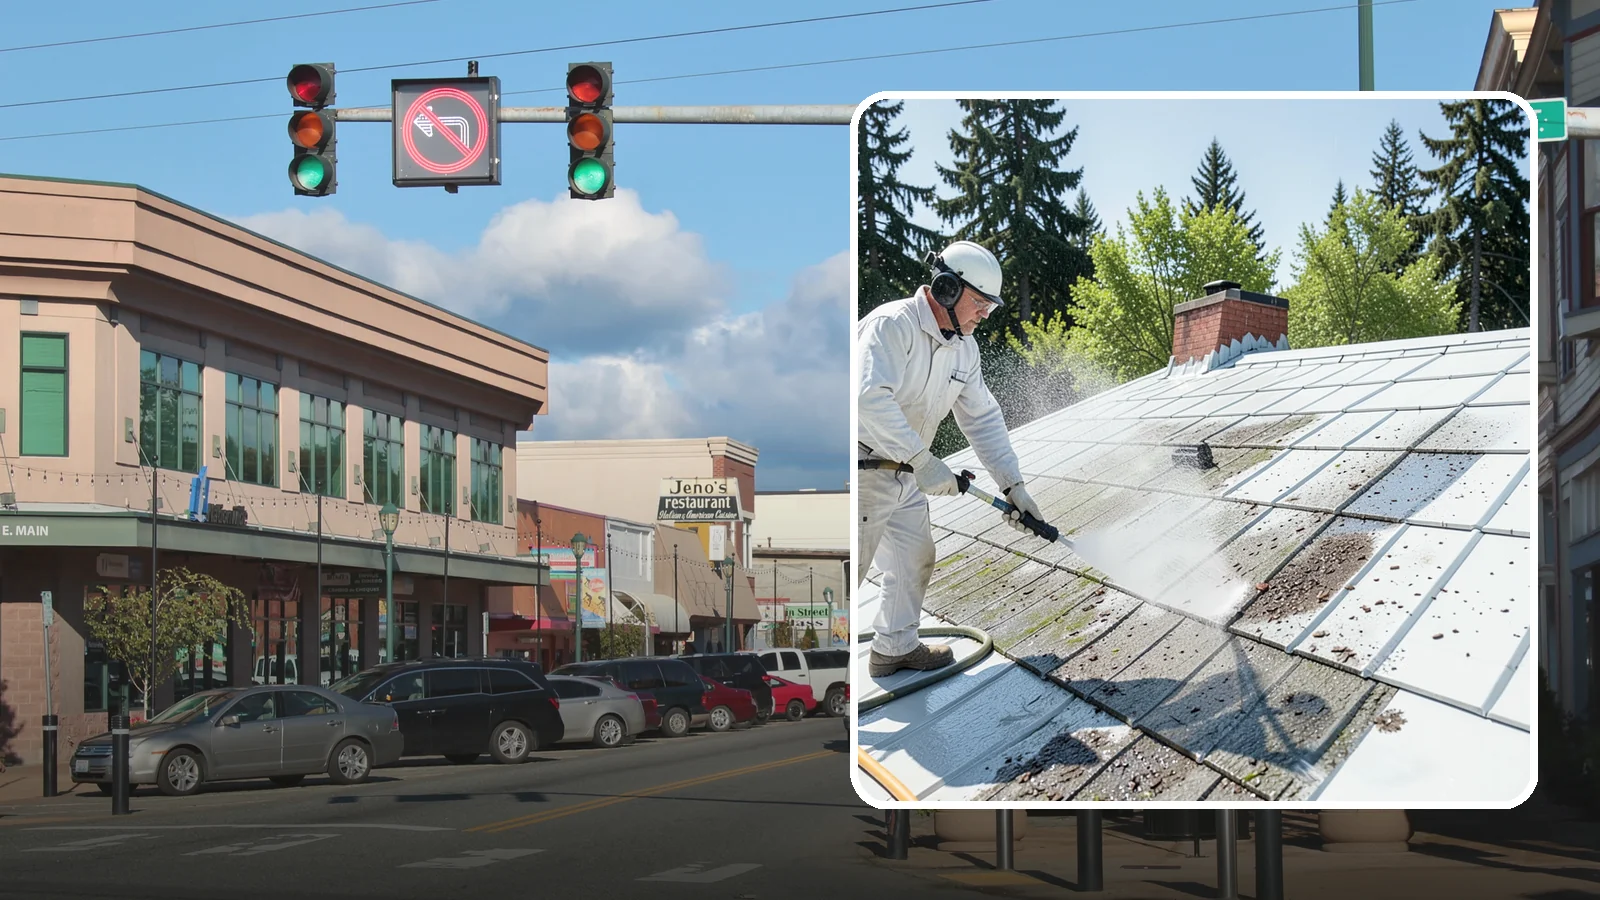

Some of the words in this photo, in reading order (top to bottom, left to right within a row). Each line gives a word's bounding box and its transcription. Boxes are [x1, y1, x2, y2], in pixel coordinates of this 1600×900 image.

[669, 480, 728, 495] Jeno's
[665, 496, 731, 509] restaurant
[686, 509, 714, 519] American
[715, 509, 738, 519] Cuisine
[2, 525, 13, 536] E.
[15, 525, 49, 536] MAIN
[797, 607, 828, 617] Street
